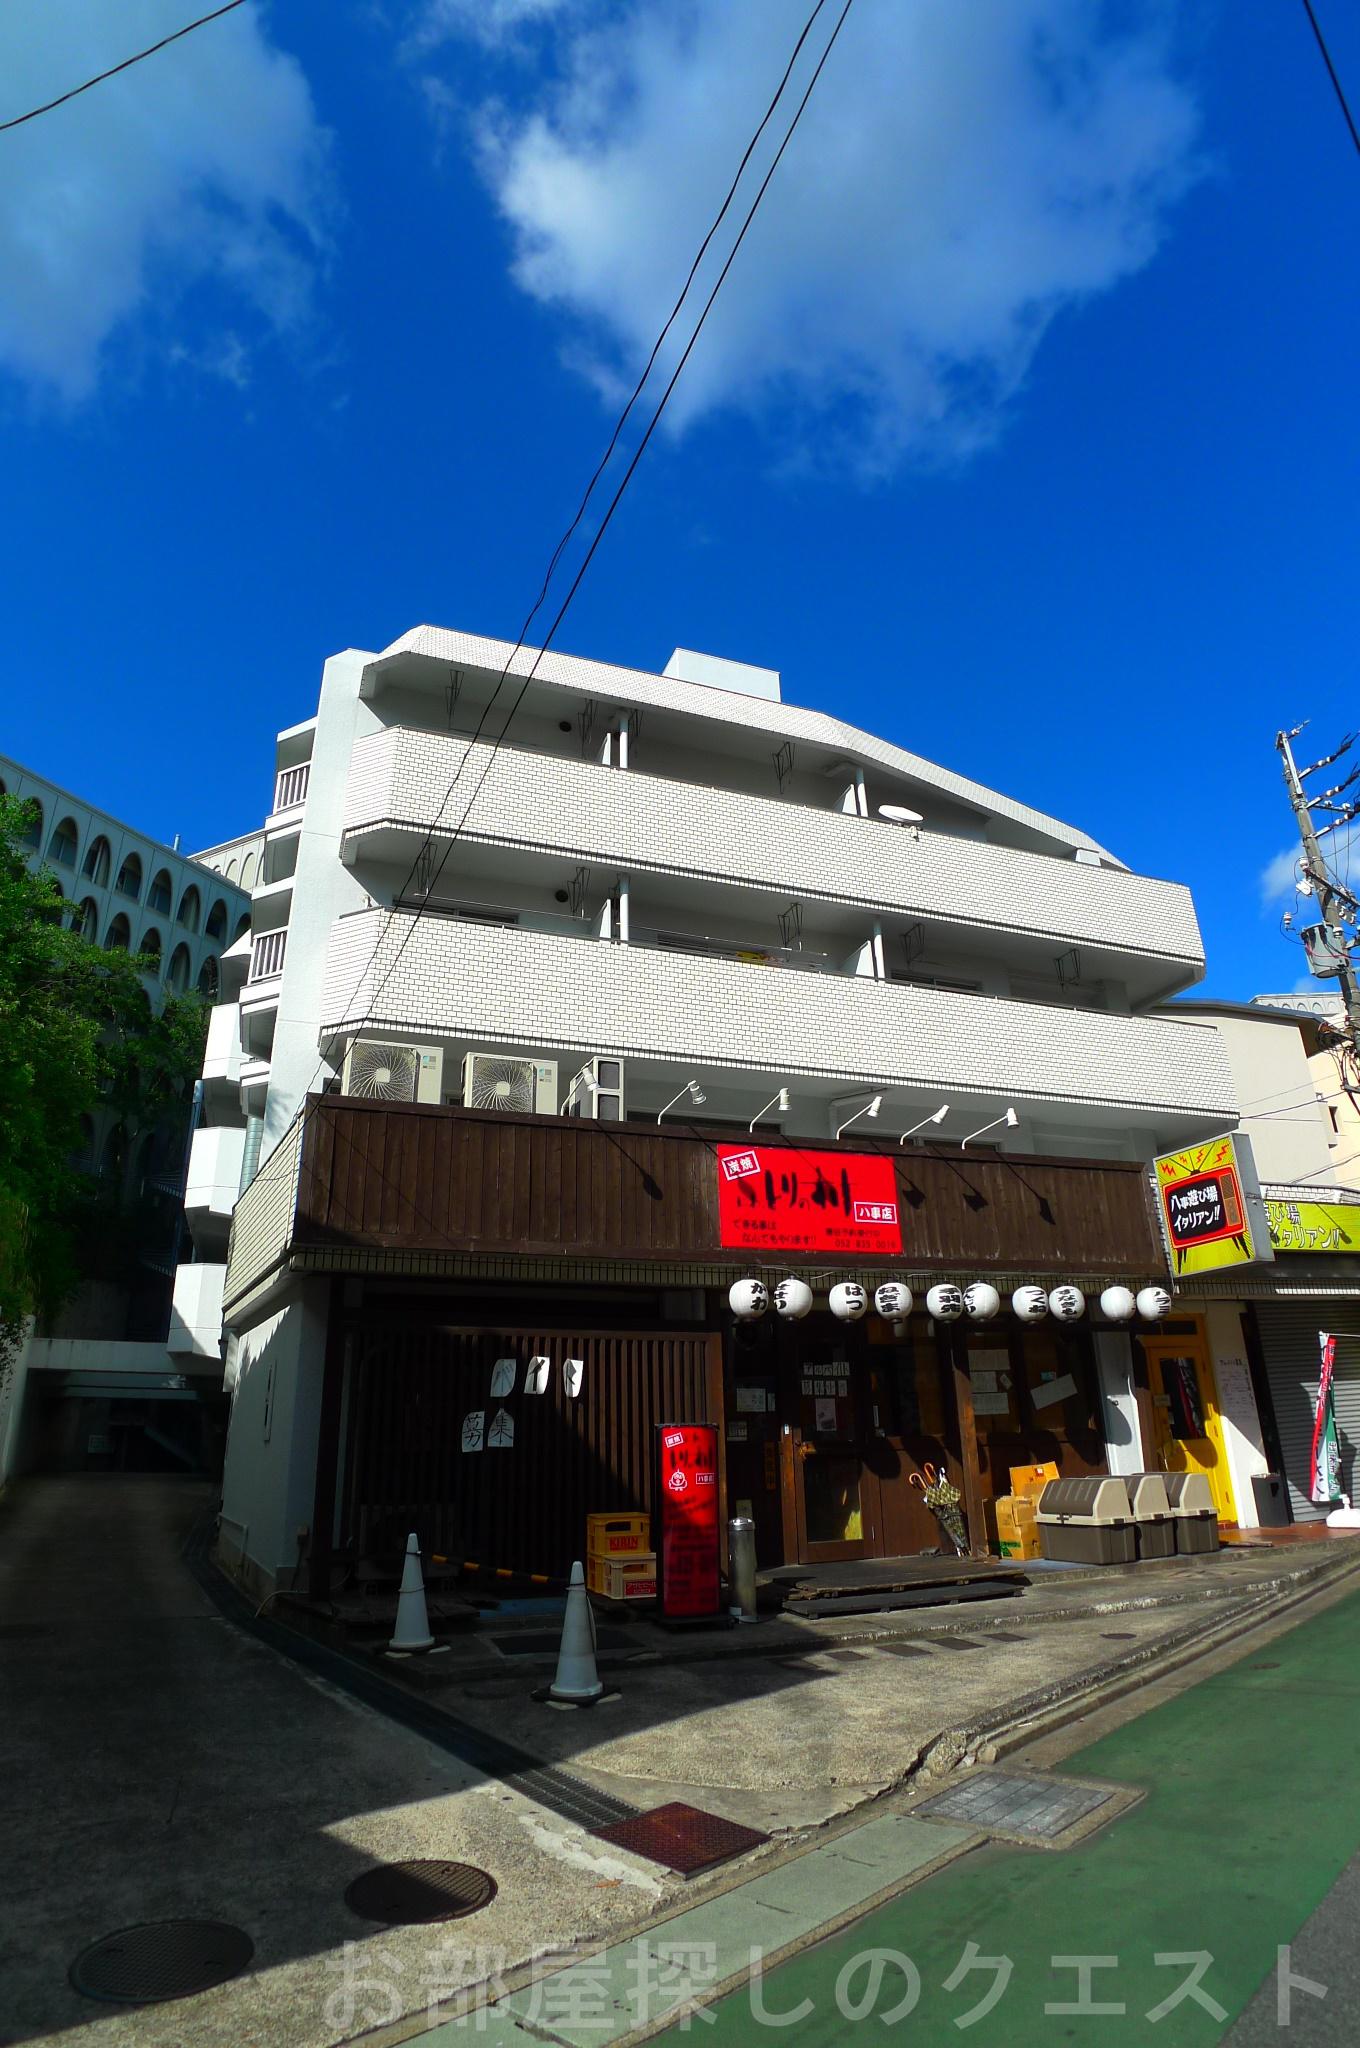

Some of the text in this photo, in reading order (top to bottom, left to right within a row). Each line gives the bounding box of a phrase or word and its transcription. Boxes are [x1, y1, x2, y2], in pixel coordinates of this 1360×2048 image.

[1170, 1184, 1218, 1213] 八事遊び場
[859, 1206, 893, 1220] 八事店
[750, 1282, 767, 1311] かわ
[845, 1285, 864, 1311] はつ
[877, 1286, 901, 1313] ねぎま
[1025, 1289, 1047, 1313] つくね
